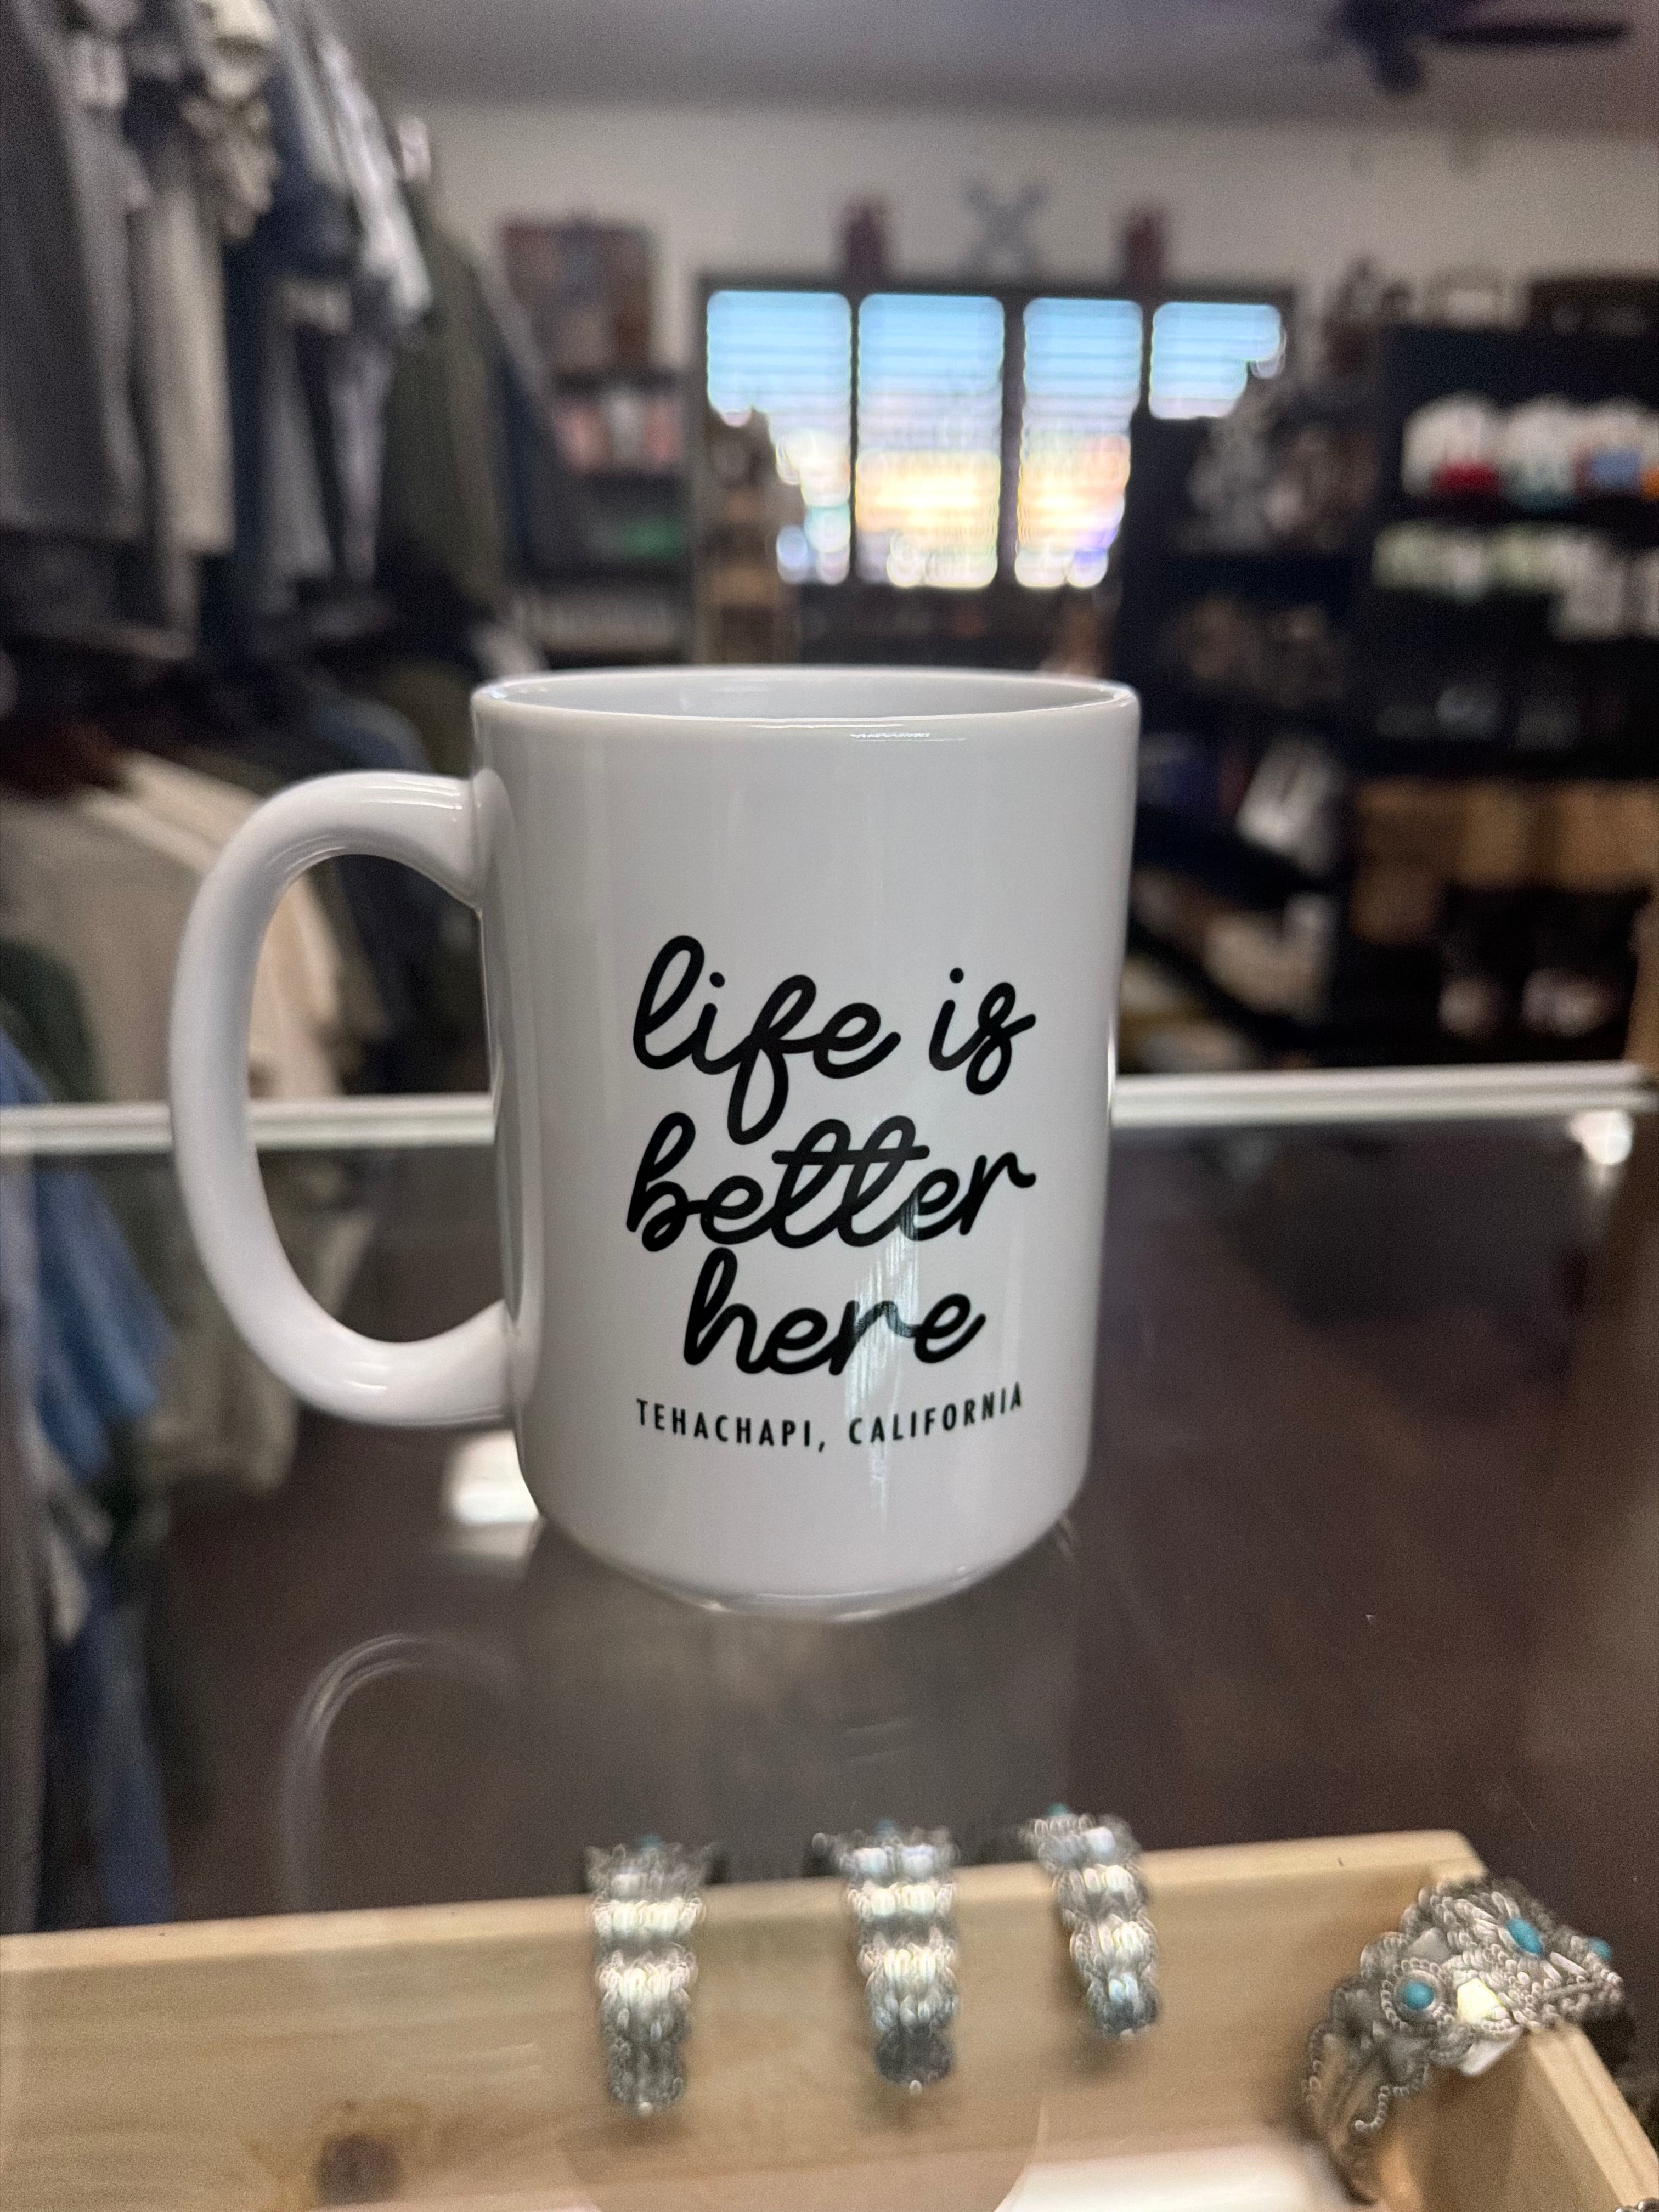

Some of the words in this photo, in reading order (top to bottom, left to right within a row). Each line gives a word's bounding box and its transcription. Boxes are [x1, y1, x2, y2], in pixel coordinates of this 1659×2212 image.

[633, 935, 901, 1146] life
[928, 967, 1036, 1096] is
[625, 1111, 1037, 1252] better
[683, 1247, 986, 1376] here
[635, 1397, 825, 1453] TEHACHAPI,
[848, 1381, 1022, 1446] CALIFORNIA
